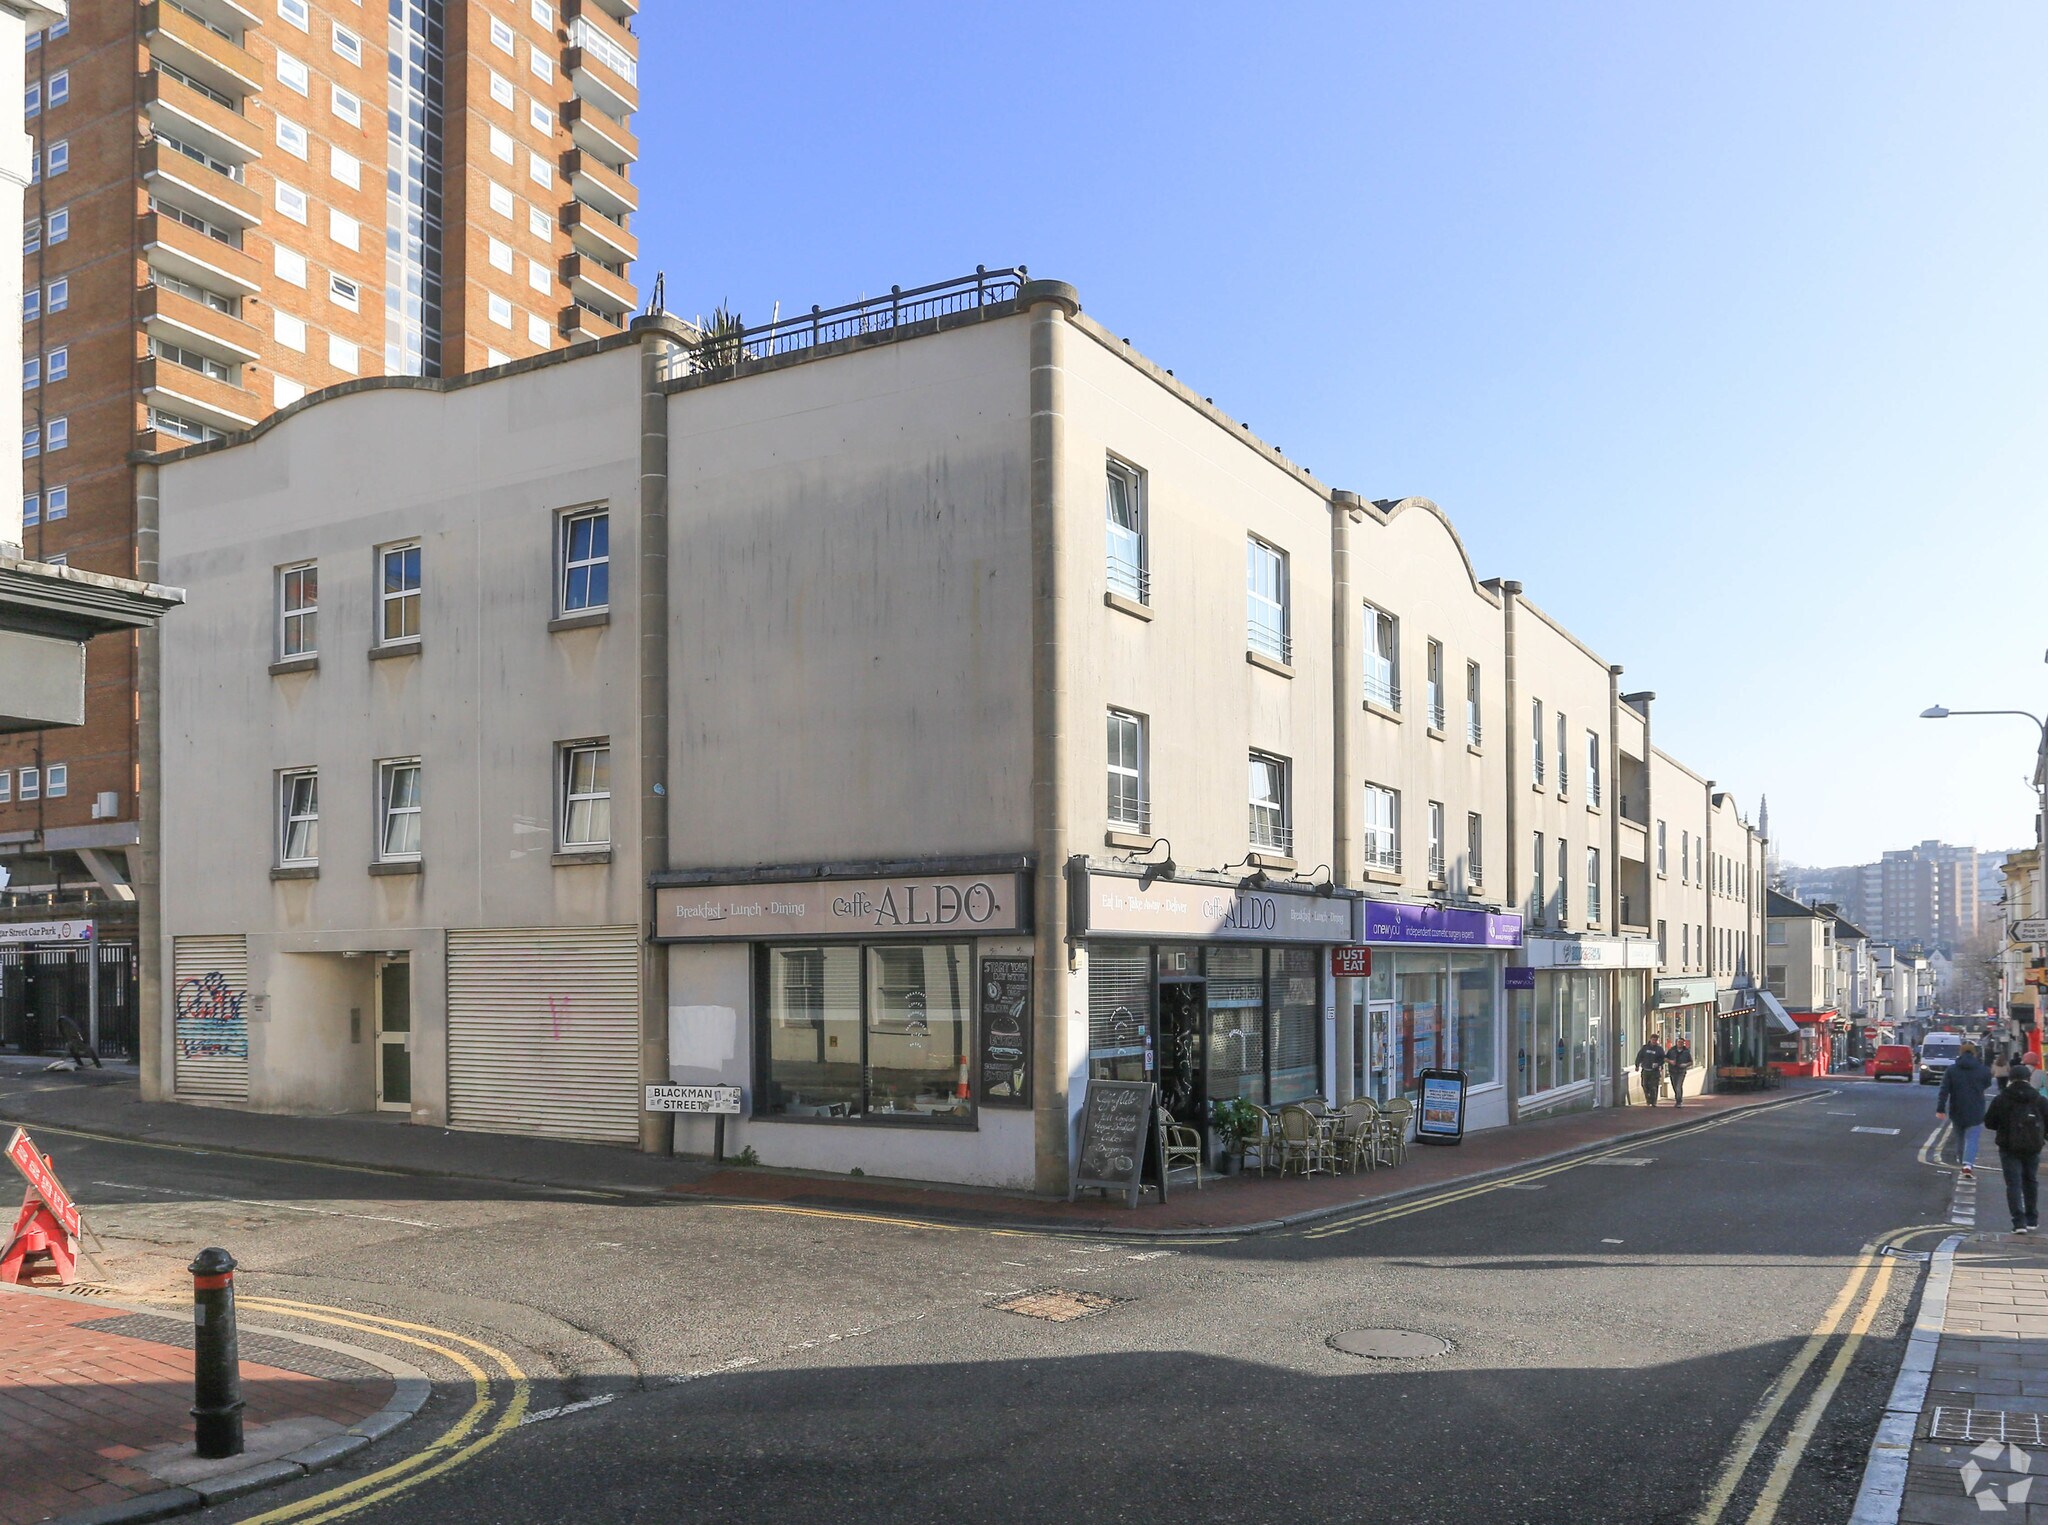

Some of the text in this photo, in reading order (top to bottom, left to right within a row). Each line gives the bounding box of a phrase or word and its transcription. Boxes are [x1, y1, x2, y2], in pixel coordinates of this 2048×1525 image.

[832, 883, 995, 926] Caffe ALDO
[1102, 893, 1114, 911] Eat
[1115, 895, 1123, 910] In
[676, 901, 805, 918] Breakfast Lunch Dining
[1224, 896, 1276, 930] ALDO
[9, 928, 28, 937] Street
[28, 927, 40, 936] Car
[41, 926, 56, 935] Park
[1405, 925, 1475, 940] independent cosmetic surgery experts
[1336, 949, 1365, 960] JUST
[1343, 960, 1365, 971] EAT
[654, 1088, 713, 1098] BLACKMAN
[663, 1099, 703, 1110] STREET
